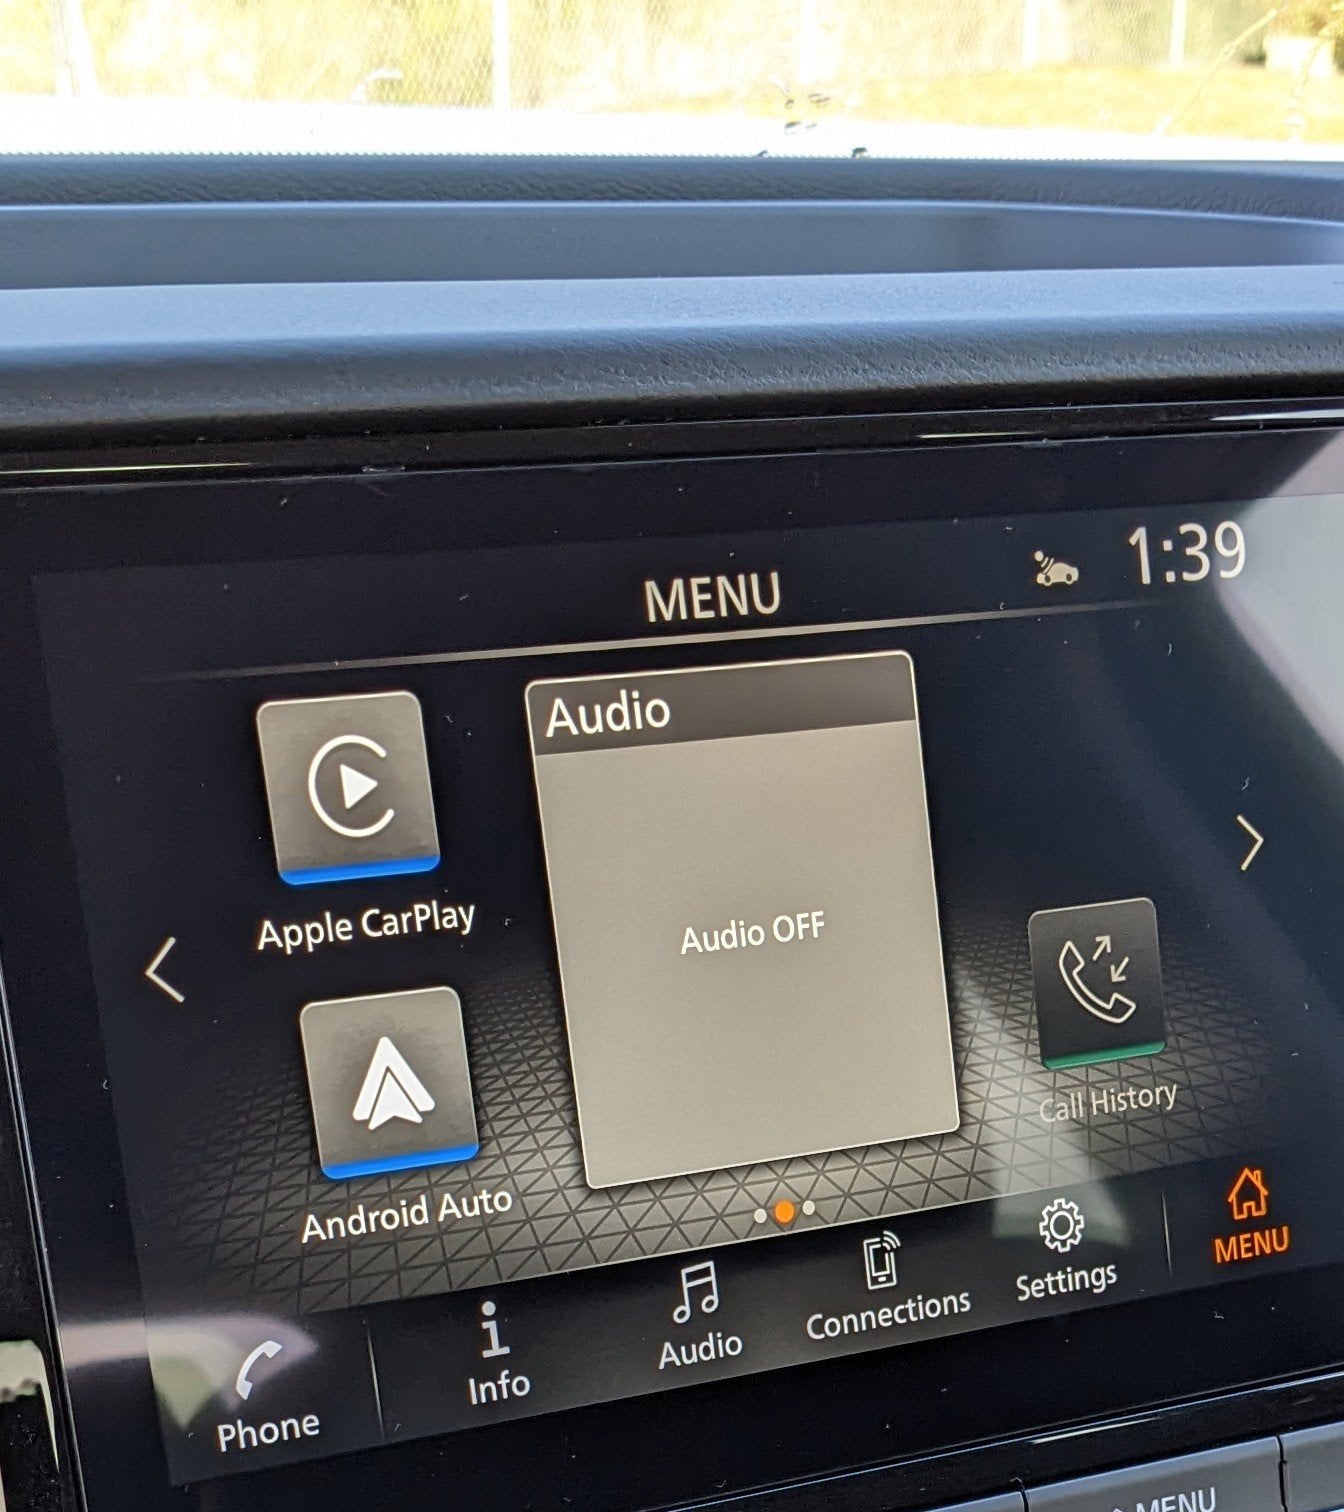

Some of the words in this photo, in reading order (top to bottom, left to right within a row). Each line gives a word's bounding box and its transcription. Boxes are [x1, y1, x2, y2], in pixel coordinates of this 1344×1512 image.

[1128, 520, 1247, 587] 1:39
[643, 571, 782, 623] MENU
[544, 691, 673, 739] Audio
[258, 911, 353, 955] Apple
[361, 900, 475, 937] CarPlay
[680, 919, 765, 955] Audio
[772, 910, 825, 942] OFF
[1038, 1091, 1084, 1123] Call
[1090, 1083, 1178, 1116] History
[301, 1194, 429, 1244] Android
[437, 1189, 513, 1222] Auto
[1214, 1225, 1290, 1265] MENU
[1016, 1263, 1118, 1302] Settings
[806, 1290, 972, 1341] Connections
[658, 1332, 744, 1370] Audio
[468, 1370, 532, 1405] Info
[216, 1410, 320, 1453] Phone
